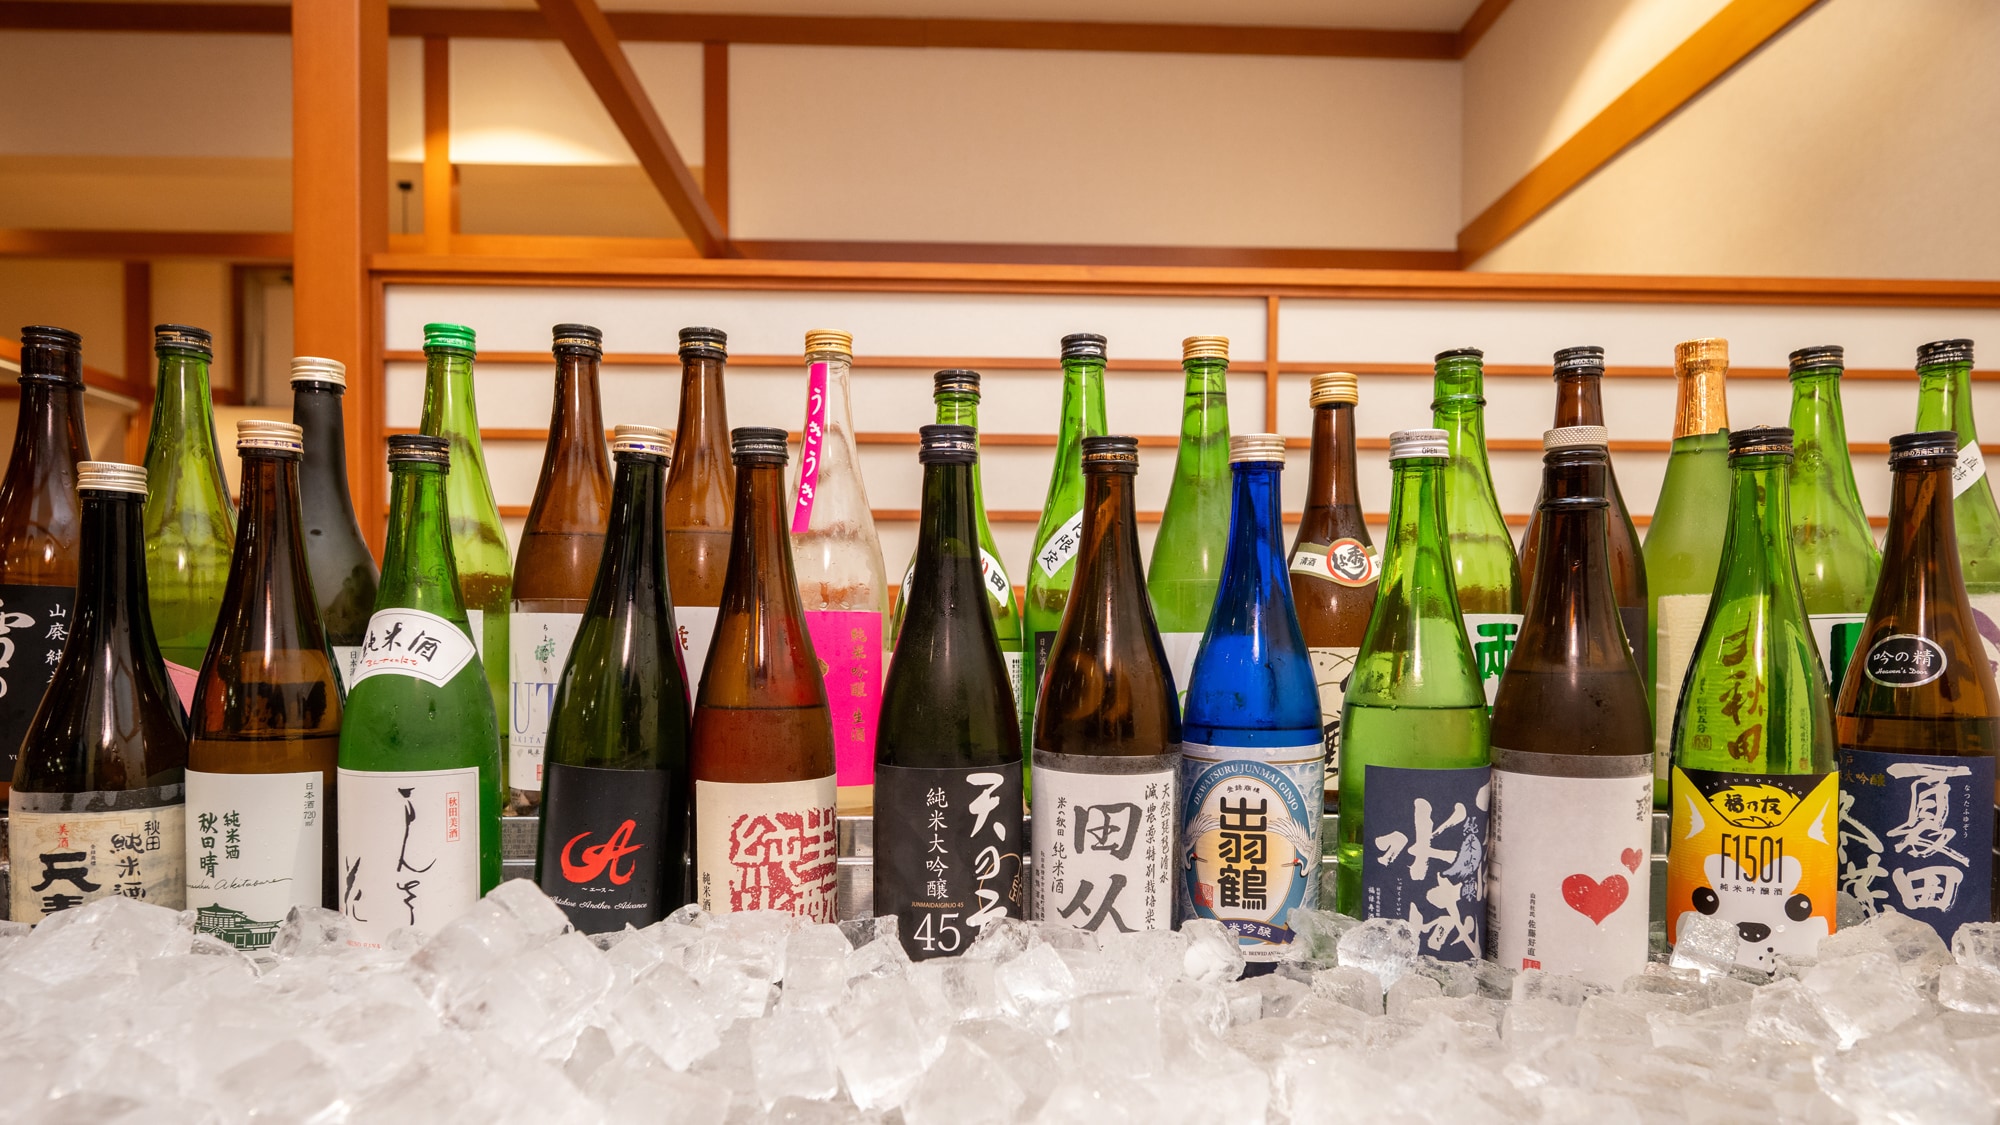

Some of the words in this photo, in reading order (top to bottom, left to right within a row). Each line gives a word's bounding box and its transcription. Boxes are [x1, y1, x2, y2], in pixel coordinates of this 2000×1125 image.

[799, 387, 822, 506] うきうき
[1421, 447, 1438, 455] OPEN
[1299, 556, 1317, 567] 清酒
[1872, 648, 1935, 668] 吟の精
[850, 707, 866, 743] 生酒
[1192, 764, 1239, 806] DEWATSURU
[1239, 763, 1281, 786] JUNMAI
[1277, 781, 1300, 811] GINJO
[1724, 792, 1783, 815] 福乃友
[57, 823, 70, 849] 美酒
[144, 820, 161, 851] 秋田
[223, 809, 241, 860] 純米酒
[448, 796, 458, 839] 秋田美酒
[1886, 762, 1973, 913] 夏田
[198, 812, 219, 879] 秋田晴
[926, 786, 950, 901] 純米大吟醸
[1216, 796, 1268, 911] 出羽鶴
[1720, 833, 1784, 885] F1501
[1051, 841, 1068, 895] 純米酒
[1719, 882, 1784, 897] 純米吟醸酒
[912, 912, 962, 952] 45
